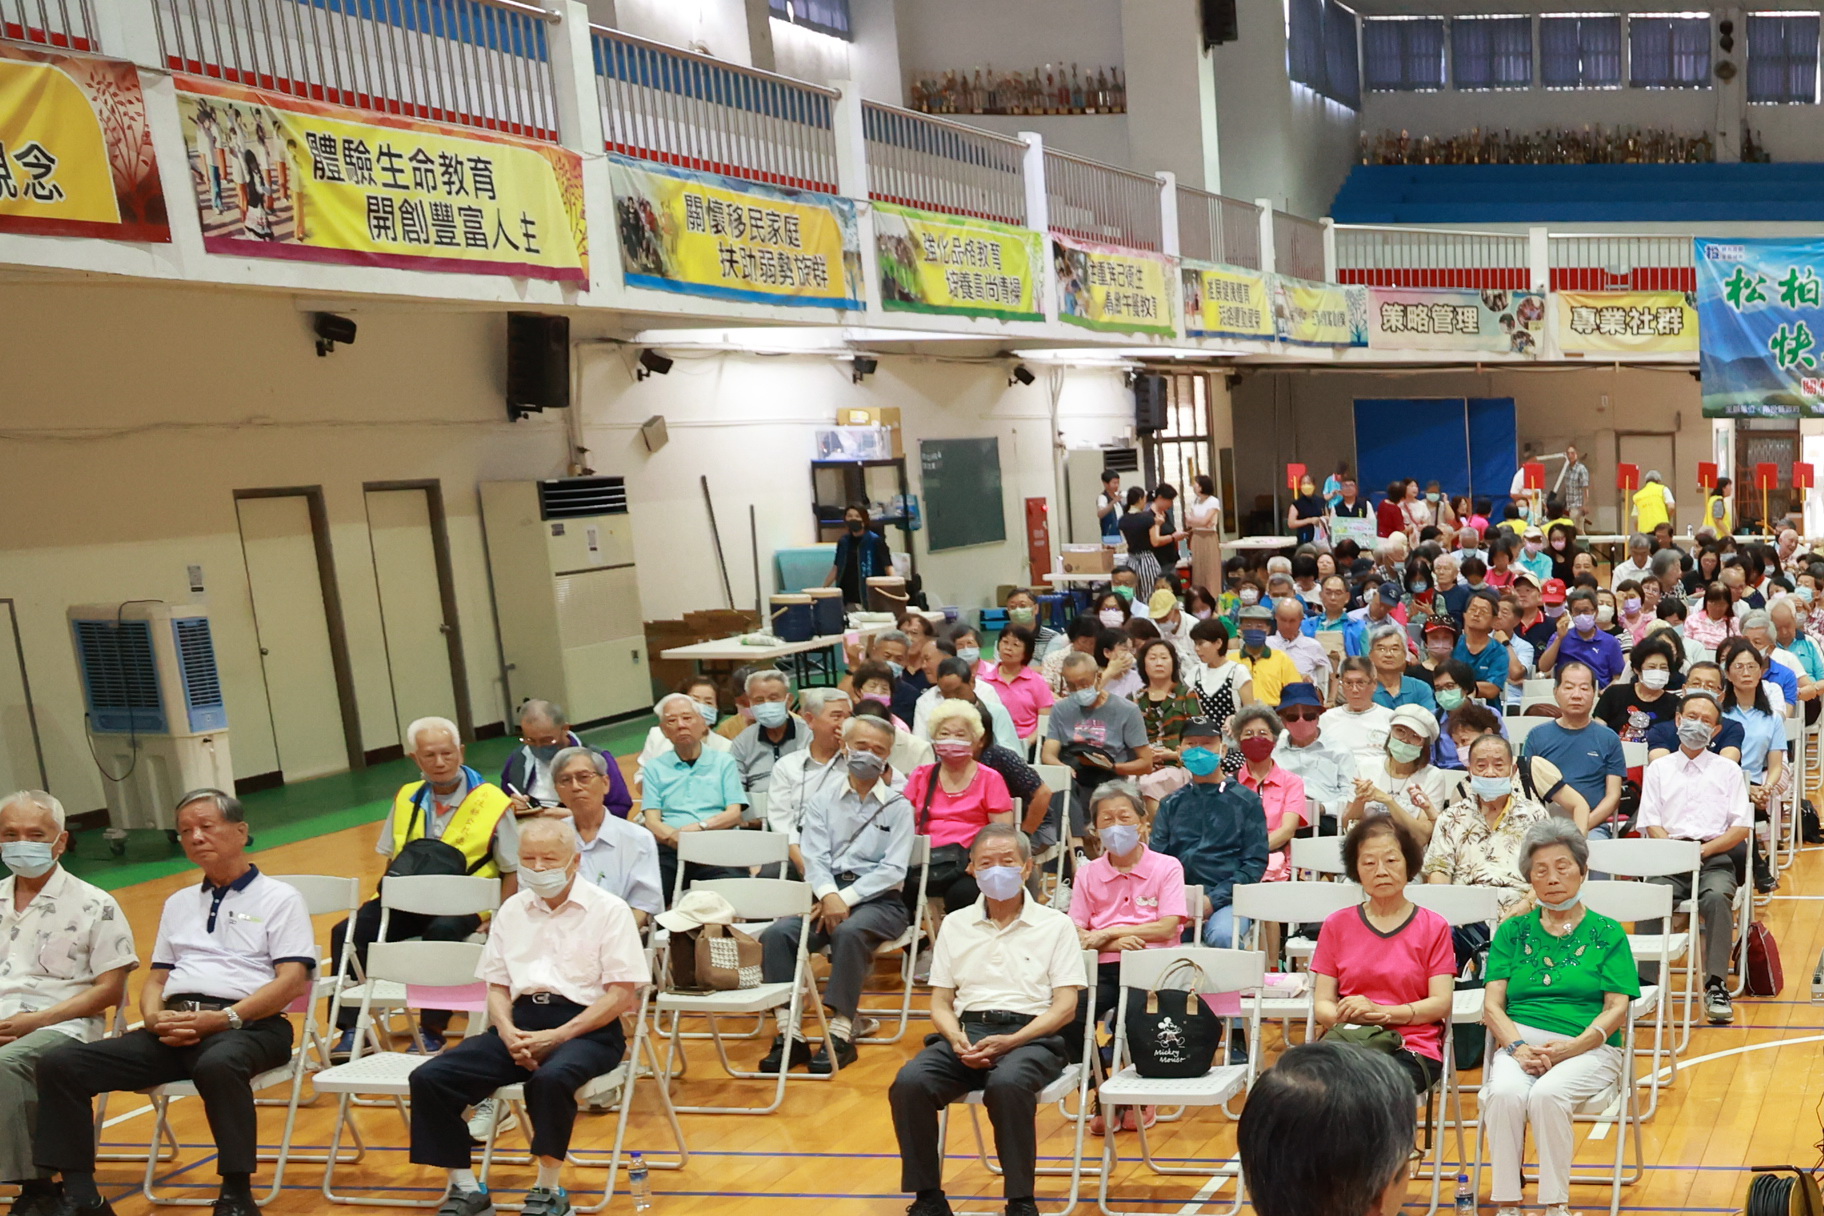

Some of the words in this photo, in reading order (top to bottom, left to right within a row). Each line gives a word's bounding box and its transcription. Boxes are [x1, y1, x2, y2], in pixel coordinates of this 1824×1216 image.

[305, 131, 497, 201] 體驗生命教育
[365, 194, 541, 255] 開創豐富人生
[684, 194, 801, 249] 關懷移民家庭
[718, 241, 829, 289] 扶助弱勢族群
[922, 232, 1002, 270] 強化品格教育
[945, 269, 1022, 304] 培養高尚情操
[1379, 302, 1480, 334] 策略管理
[1570, 305, 1684, 335] 專業社群
[1153, 1047, 1180, 1058] Mickey
